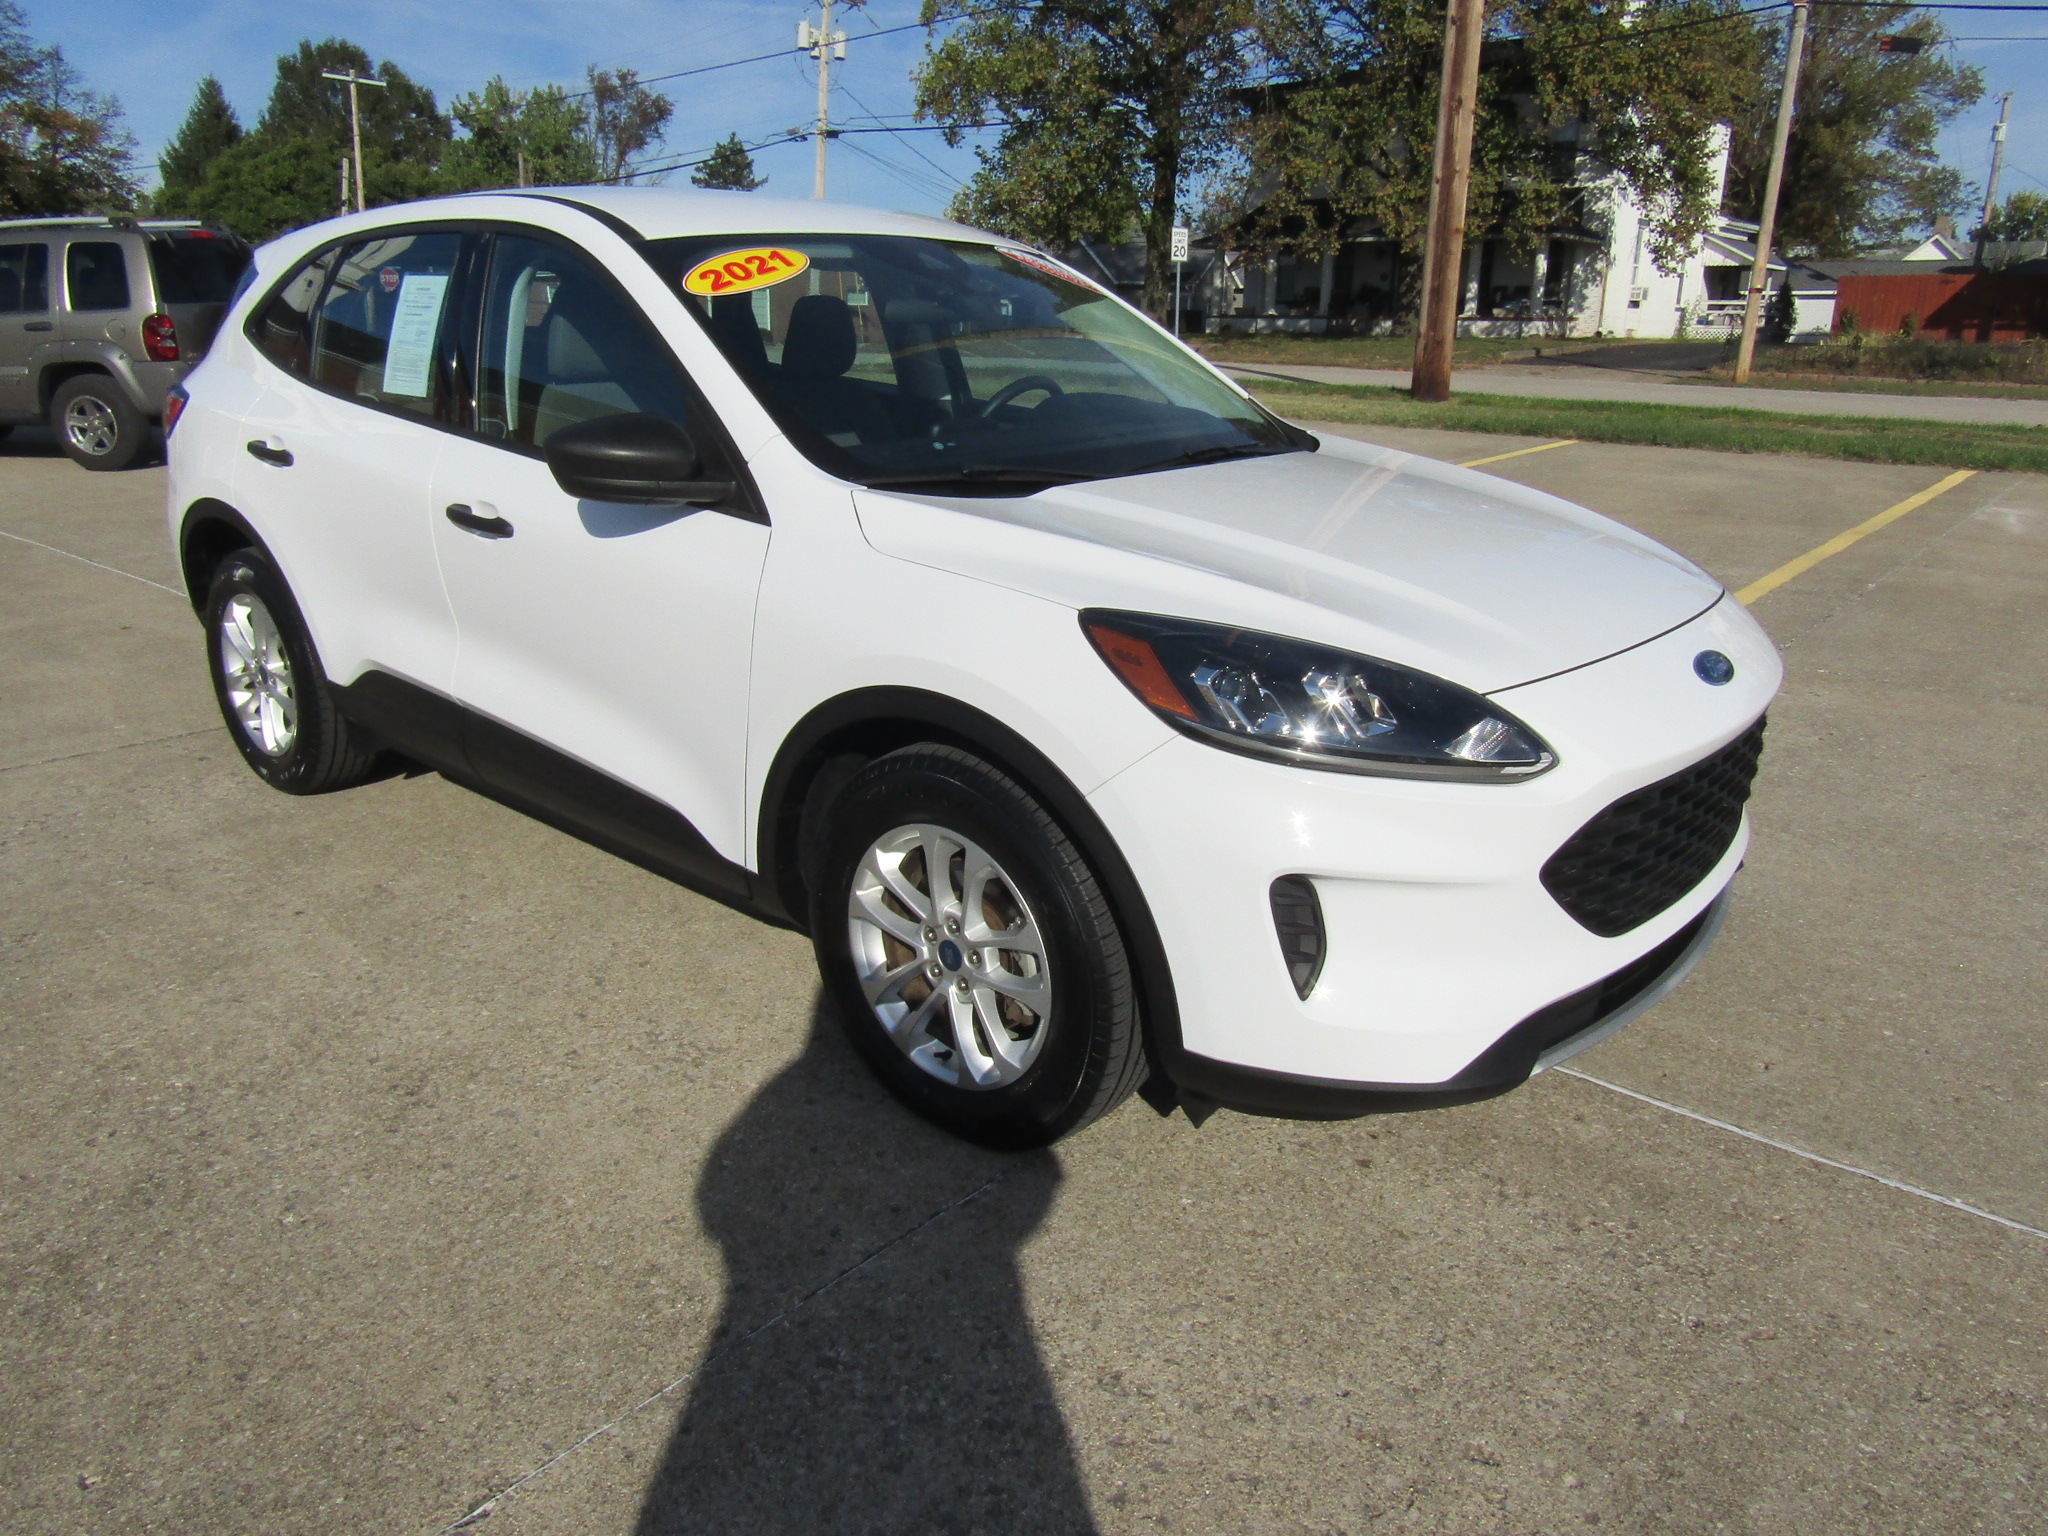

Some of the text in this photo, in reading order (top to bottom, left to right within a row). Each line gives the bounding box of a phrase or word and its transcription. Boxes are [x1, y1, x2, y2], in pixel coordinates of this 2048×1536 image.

[1173, 245, 1186, 257] 20
[699, 250, 796, 292] 2021
[381, 274, 399, 282] STOP
